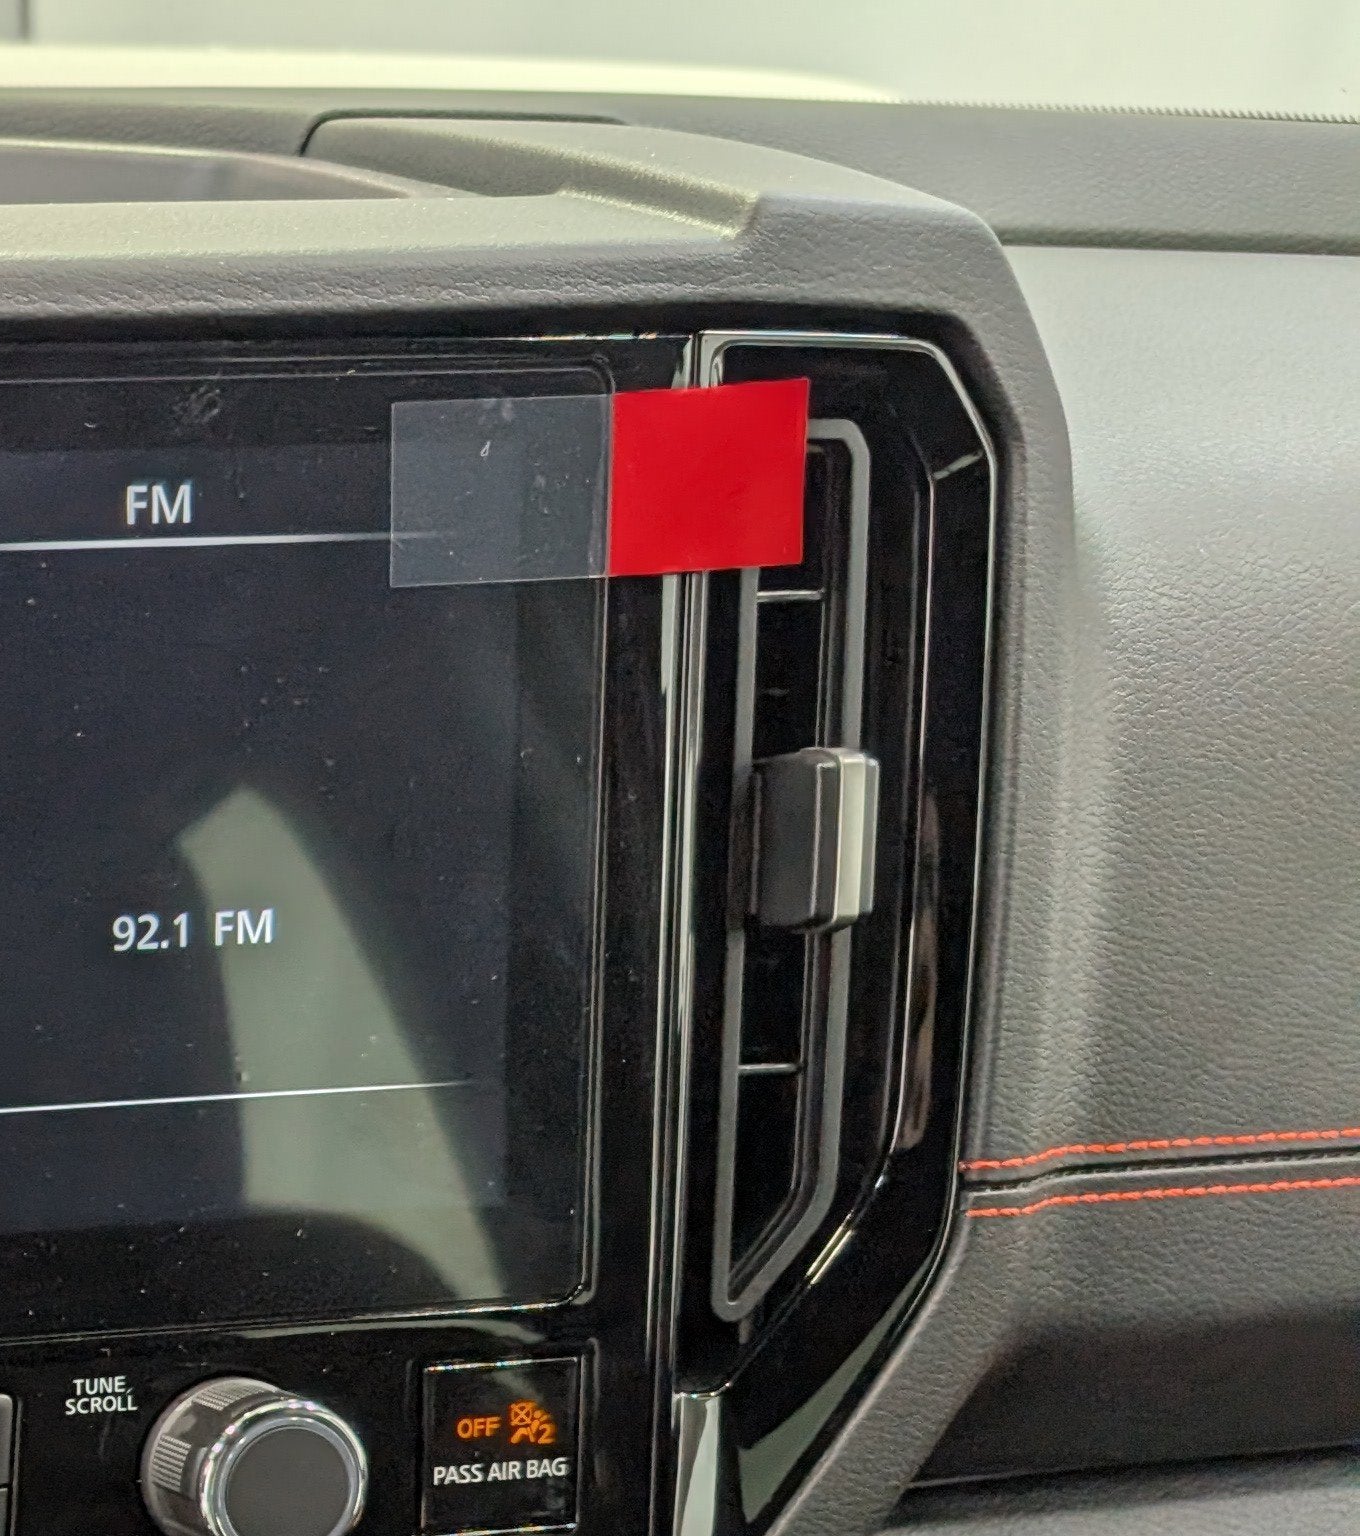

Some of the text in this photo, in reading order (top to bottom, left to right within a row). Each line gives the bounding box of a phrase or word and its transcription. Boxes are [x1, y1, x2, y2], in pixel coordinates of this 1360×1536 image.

[125, 484, 193, 526] FM
[112, 908, 274, 951] 92.1 FM
[73, 1376, 126, 1396] TUNE
[65, 1395, 138, 1416] SCROLL
[456, 1416, 501, 1439] OFF
[433, 1457, 569, 1485] PASS AIR BAG
